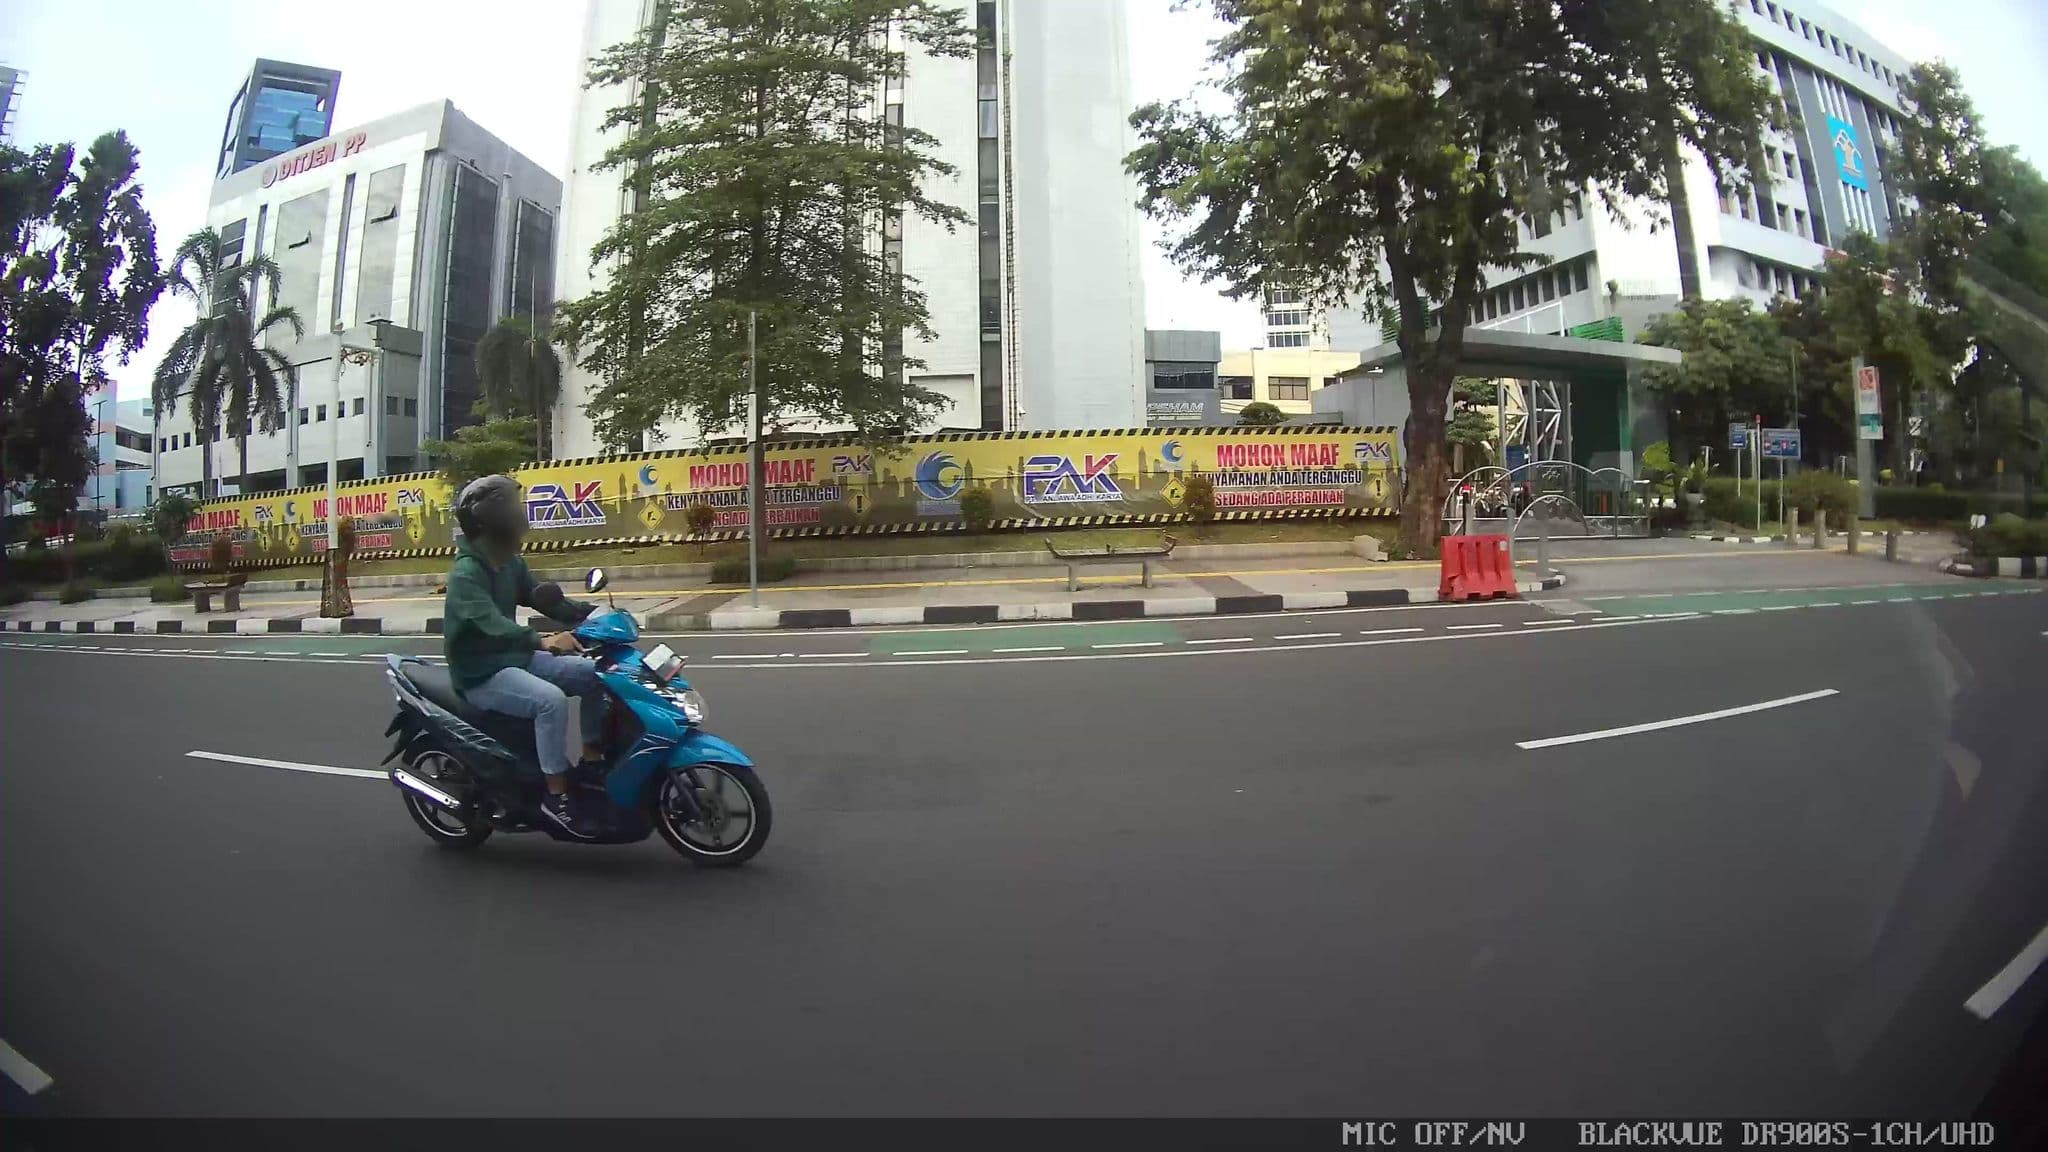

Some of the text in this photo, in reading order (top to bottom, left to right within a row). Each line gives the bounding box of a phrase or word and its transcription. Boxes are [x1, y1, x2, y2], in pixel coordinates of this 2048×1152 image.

[279, 133, 366, 181] DITJEN PP
[1217, 443, 1340, 467] MOHON MAAF
[1354, 441, 1389, 458] PAK
[764, 460, 815, 483] MAAF
[832, 455, 872, 472] PAK
[1023, 453, 1121, 495] PAK
[1269, 472, 1299, 485] ANDA
[1300, 470, 1362, 484] TERGANGGU
[527, 481, 604, 521] PAK
[774, 486, 840, 503] TERGANGGU
[1216, 490, 1344, 506] SEDANG ADA PERBAIKAN
[313, 493, 387, 518] MOON MAAF
[208, 510, 240, 530] MAAF
